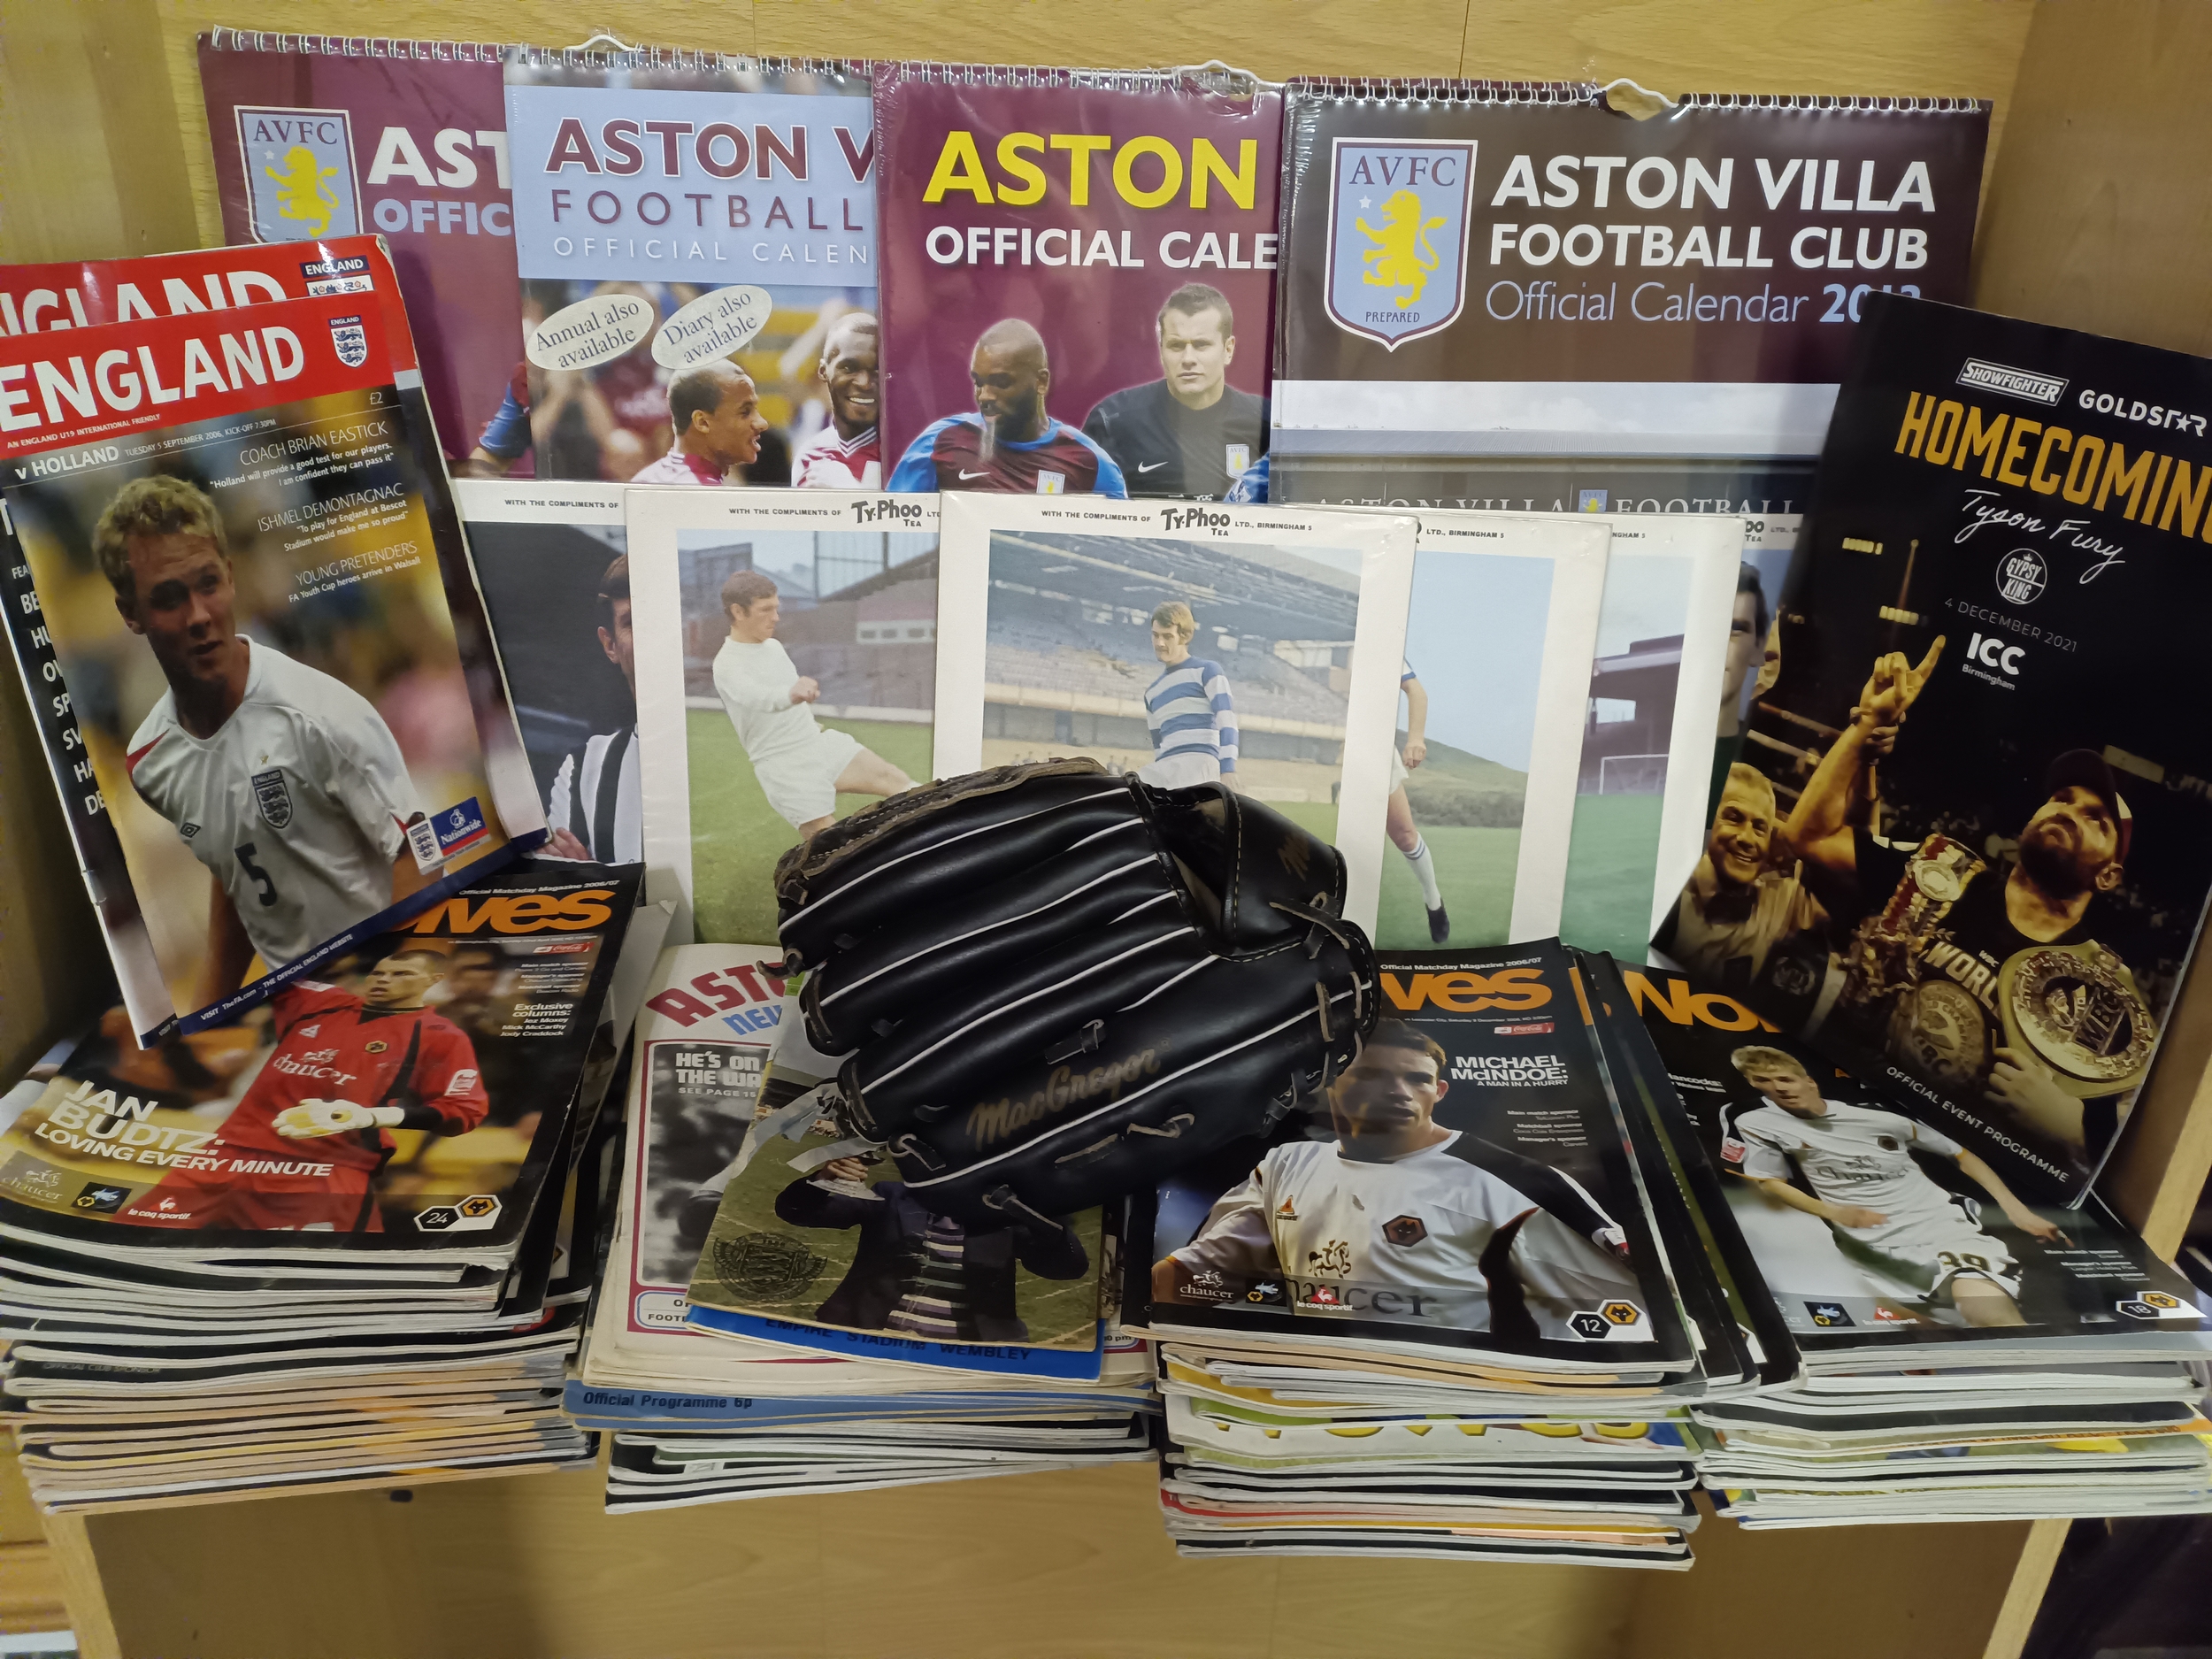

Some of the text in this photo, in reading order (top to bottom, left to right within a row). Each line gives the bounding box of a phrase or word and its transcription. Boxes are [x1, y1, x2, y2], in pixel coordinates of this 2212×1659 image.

[253, 120, 338, 147] AVFC
[545, 118, 807, 181] ASTON
[366, 127, 512, 189] AST
[922, 130, 1257, 210] ASTON
[1349, 154, 1457, 188] AVFC
[1491, 154, 1936, 213] ASTON VILLA
[373, 198, 511, 236] OFFIC
[552, 189, 864, 232] FOOTBALL
[554, 236, 869, 265] OFFICIAL CALEN
[926, 226, 1278, 270] OFFICIAL CALE
[1489, 223, 1928, 270] FOOTBALL CLUB
[305, 257, 365, 276] ENGLAND
[663, 292, 751, 346] Diary also
[1364, 310, 1421, 324] PREPARED
[1485, 280, 1809, 324] Official Calendar
[330, 317, 359, 326] ENGLAND
[535, 301, 639, 351] Annual also
[557, 328, 636, 368] available
[683, 315, 757, 364] available
[0, 326, 305, 432] ENGLAND
[1962, 362, 2061, 403] SHOWFIGHTER
[370, 392, 384, 405] £2
[21, 434, 58, 446] ENGLAND
[77, 419, 130, 436] INTERNATIONAL
[132, 414, 160, 425] FRIENDLY
[240, 421, 388, 465] COACH BRIAN EASTICK
[15, 467, 27, 480] v
[31, 446, 119, 476] HOLLAND
[125, 444, 156, 457] TUESDAY
[163, 434, 204, 449] SEPTEMBER
[225, 424, 254, 435] KICK-OFF
[248, 471, 261, 480] will
[263, 465, 288, 479] provide
[296, 457, 314, 471] good
[316, 454, 330, 465] test
[332, 450, 343, 460] for
[345, 448, 358, 457] our
[296, 467, 328, 482] confident
[330, 464, 348, 475] they
[349, 460, 363, 469] can
[365, 456, 383, 467] pass
[257, 482, 404, 532] ISHMEL DEMONTAGNAC
[311, 499, 408, 533] play for England at Bescot
[1084, 512, 1138, 521] COMPLIMENTS
[1257, 522, 1306, 531] BIRMINGHAM
[284, 538, 312, 551] Stadium
[313, 531, 335, 543] would
[337, 525, 356, 537] make
[1448, 530, 1498, 539] BIRMINGHAM
[1955, 488, 2125, 584] Tyson Fury
[296, 541, 418, 586] YOUNG PRETENDERS
[2006, 557, 2042, 583] GYPSY
[288, 594, 300, 603] FA
[300, 586, 320, 598] Youth
[321, 582, 335, 593] Cup
[336, 575, 361, 587] heroes
[362, 569, 383, 580] arrive
[2002, 578, 2032, 601] KING
[1944, 598, 2077, 653] 4 DECEMBER 2021
[1966, 633, 2025, 675] ICC
[1962, 664, 2016, 691] Birmingham
[441, 818, 482, 845] Nationwide
[234, 842, 277, 906] 5
[493, 886, 536, 895] Matchday
[538, 883, 581, 892] Magazine
[201, 933, 353, 1020] VISIT TheFA.com THE OFFICIAL ENGLAND WEBSITE
[1460, 961, 1504, 971] Magazine
[1506, 957, 1542, 967] 2006/07
[273, 1054, 357, 1086] chaucer
[676, 1069, 717, 1085] THE
[1455, 1055, 1565, 1069] MICHAEL
[66, 1080, 158, 1122] JAN
[965, 1048, 1162, 1152] MacGregor
[47, 1100, 226, 1156] BUDTZ:
[1886, 1066, 2070, 1184] OFFICIAL EVENT PROGRAMME
[34, 1122, 334, 1178] LOVING EVERY MINUTE
[3, 1176, 63, 1201] chaucer
[426, 1211, 449, 1225] 24
[1179, 1284, 1234, 1299] chaucer
[1580, 1317, 1602, 1333] 12
[2127, 1304, 2152, 1314] 18
[940, 1344, 1031, 1361] WEMBLEY
[583, 1392, 753, 1409] Official Programme 6p
